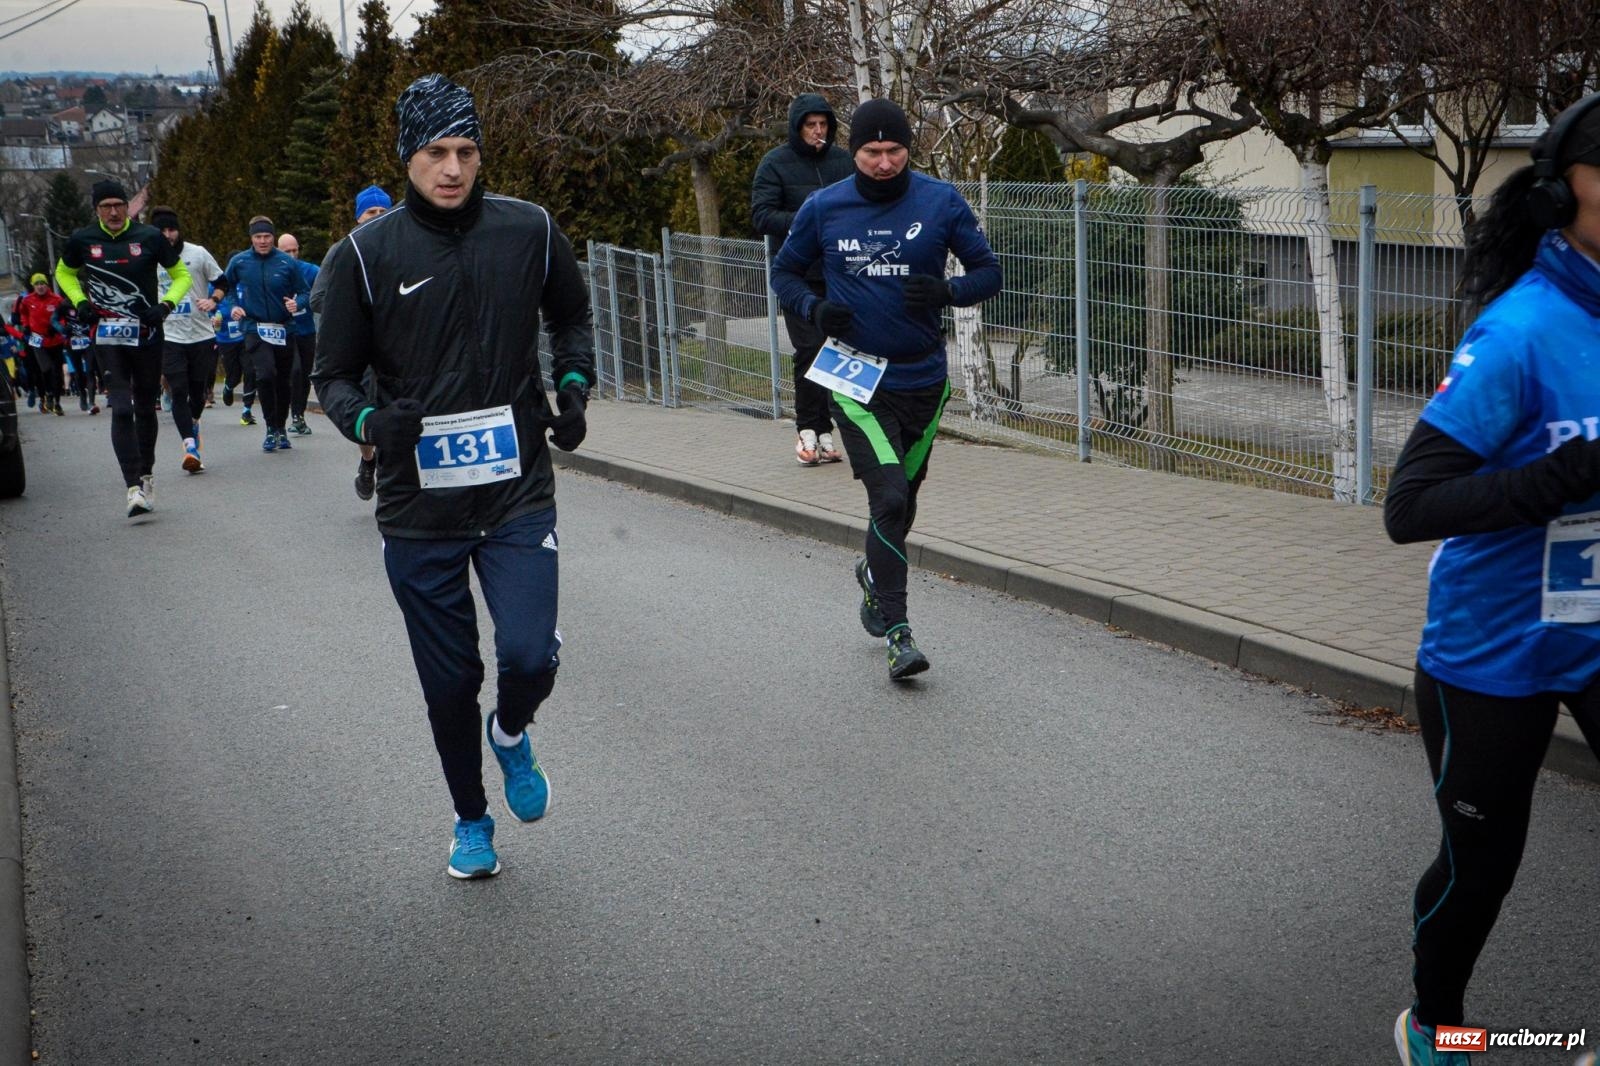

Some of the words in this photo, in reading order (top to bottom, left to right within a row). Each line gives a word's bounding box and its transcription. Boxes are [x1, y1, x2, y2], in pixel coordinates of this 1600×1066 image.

[838, 239, 861, 251] NA
[867, 264, 909, 276] METE
[105, 325, 133, 337] 120
[264, 328, 282, 338] 150
[831, 353, 864, 380] 79
[434, 430, 502, 466] 131
